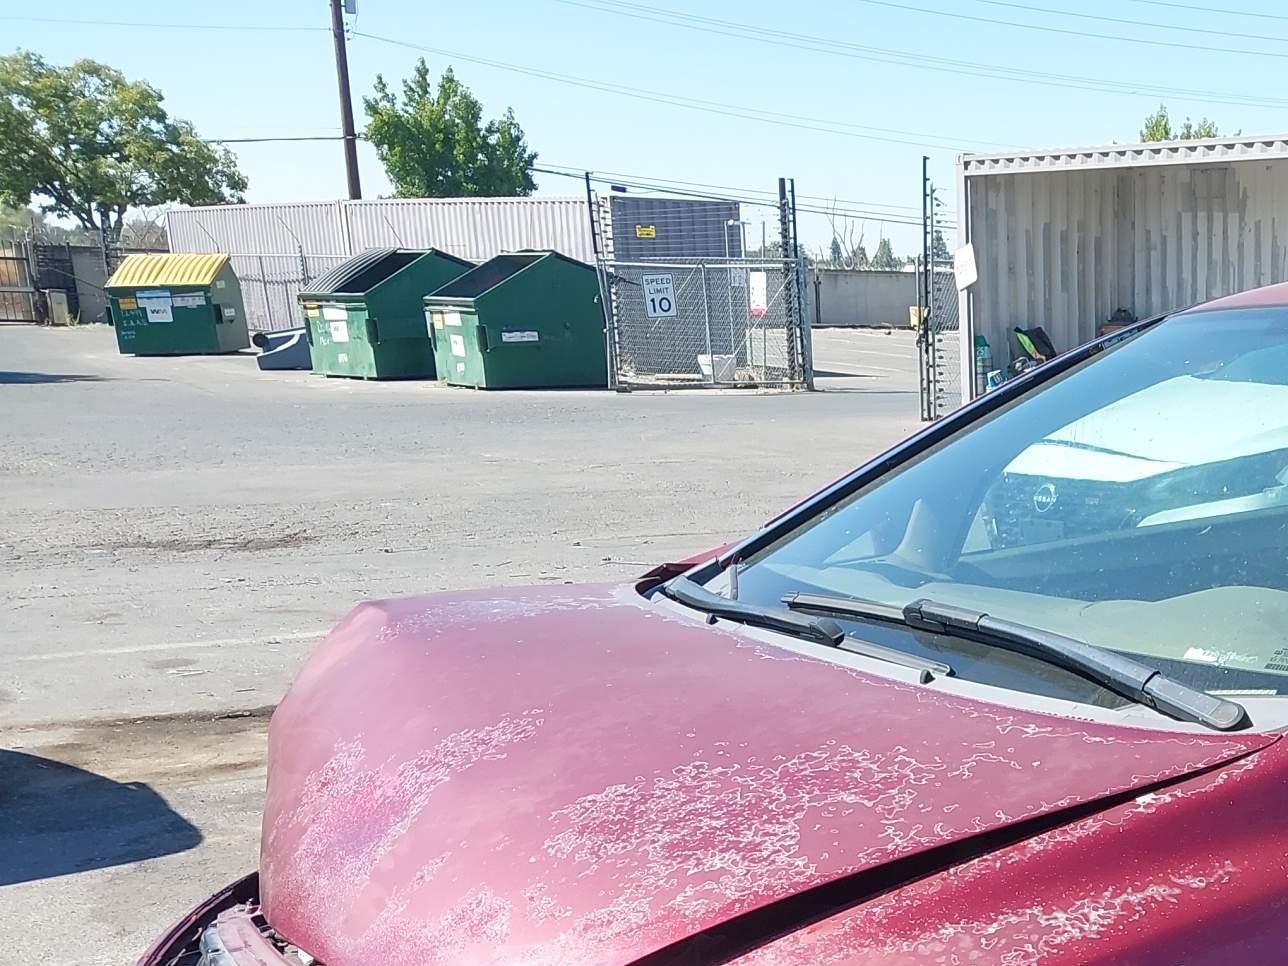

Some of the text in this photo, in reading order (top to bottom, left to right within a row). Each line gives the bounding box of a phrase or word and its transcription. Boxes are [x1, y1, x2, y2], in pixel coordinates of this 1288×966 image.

[644, 277, 671, 285] SPEED
[648, 287, 669, 295] LIMIT
[650, 297, 672, 313] 10
